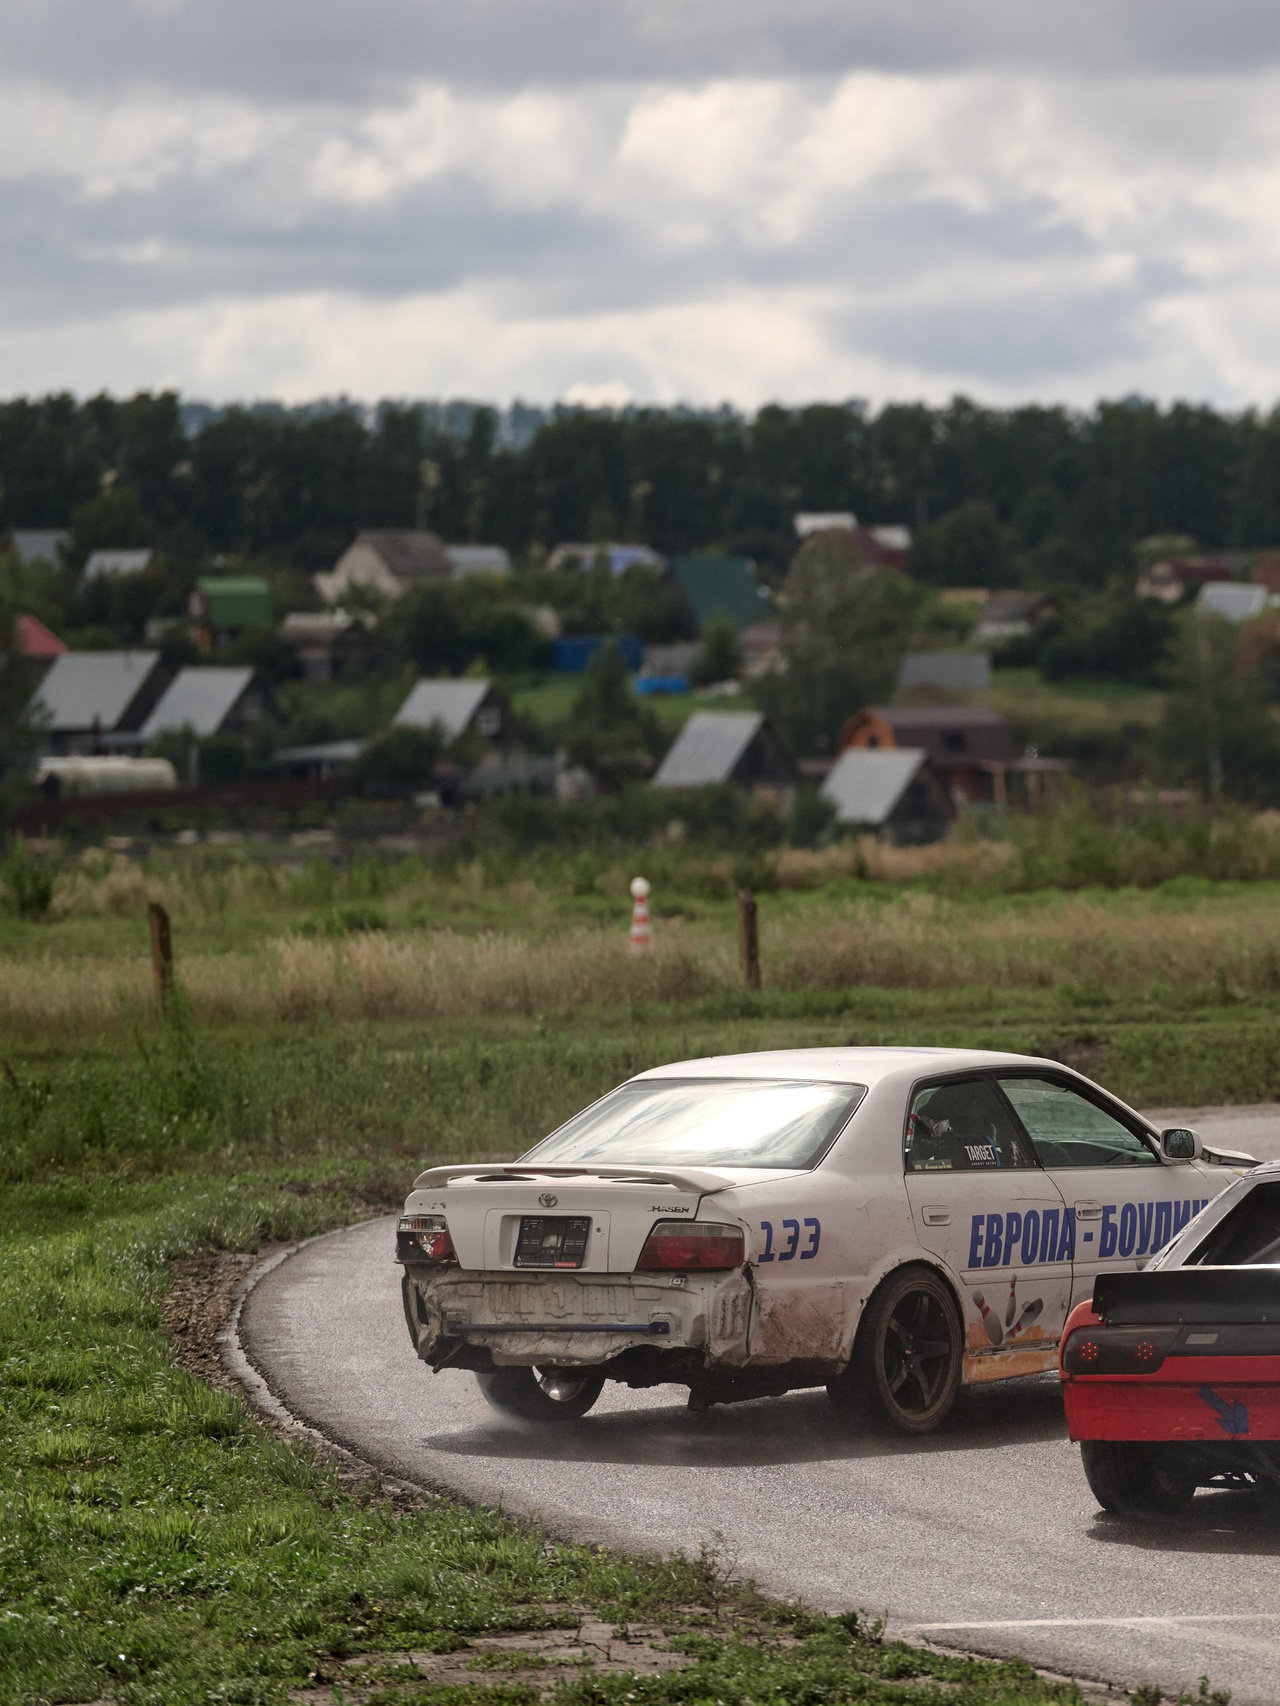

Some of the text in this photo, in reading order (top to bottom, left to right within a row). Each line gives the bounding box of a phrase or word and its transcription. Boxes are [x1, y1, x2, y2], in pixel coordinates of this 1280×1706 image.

[964, 1145, 996, 1161] TARGET
[757, 1217, 821, 1263] 133
[967, 1207, 1077, 1269] ЕВРОПА
[1098, 1199, 1209, 1258] БОУЛИ
